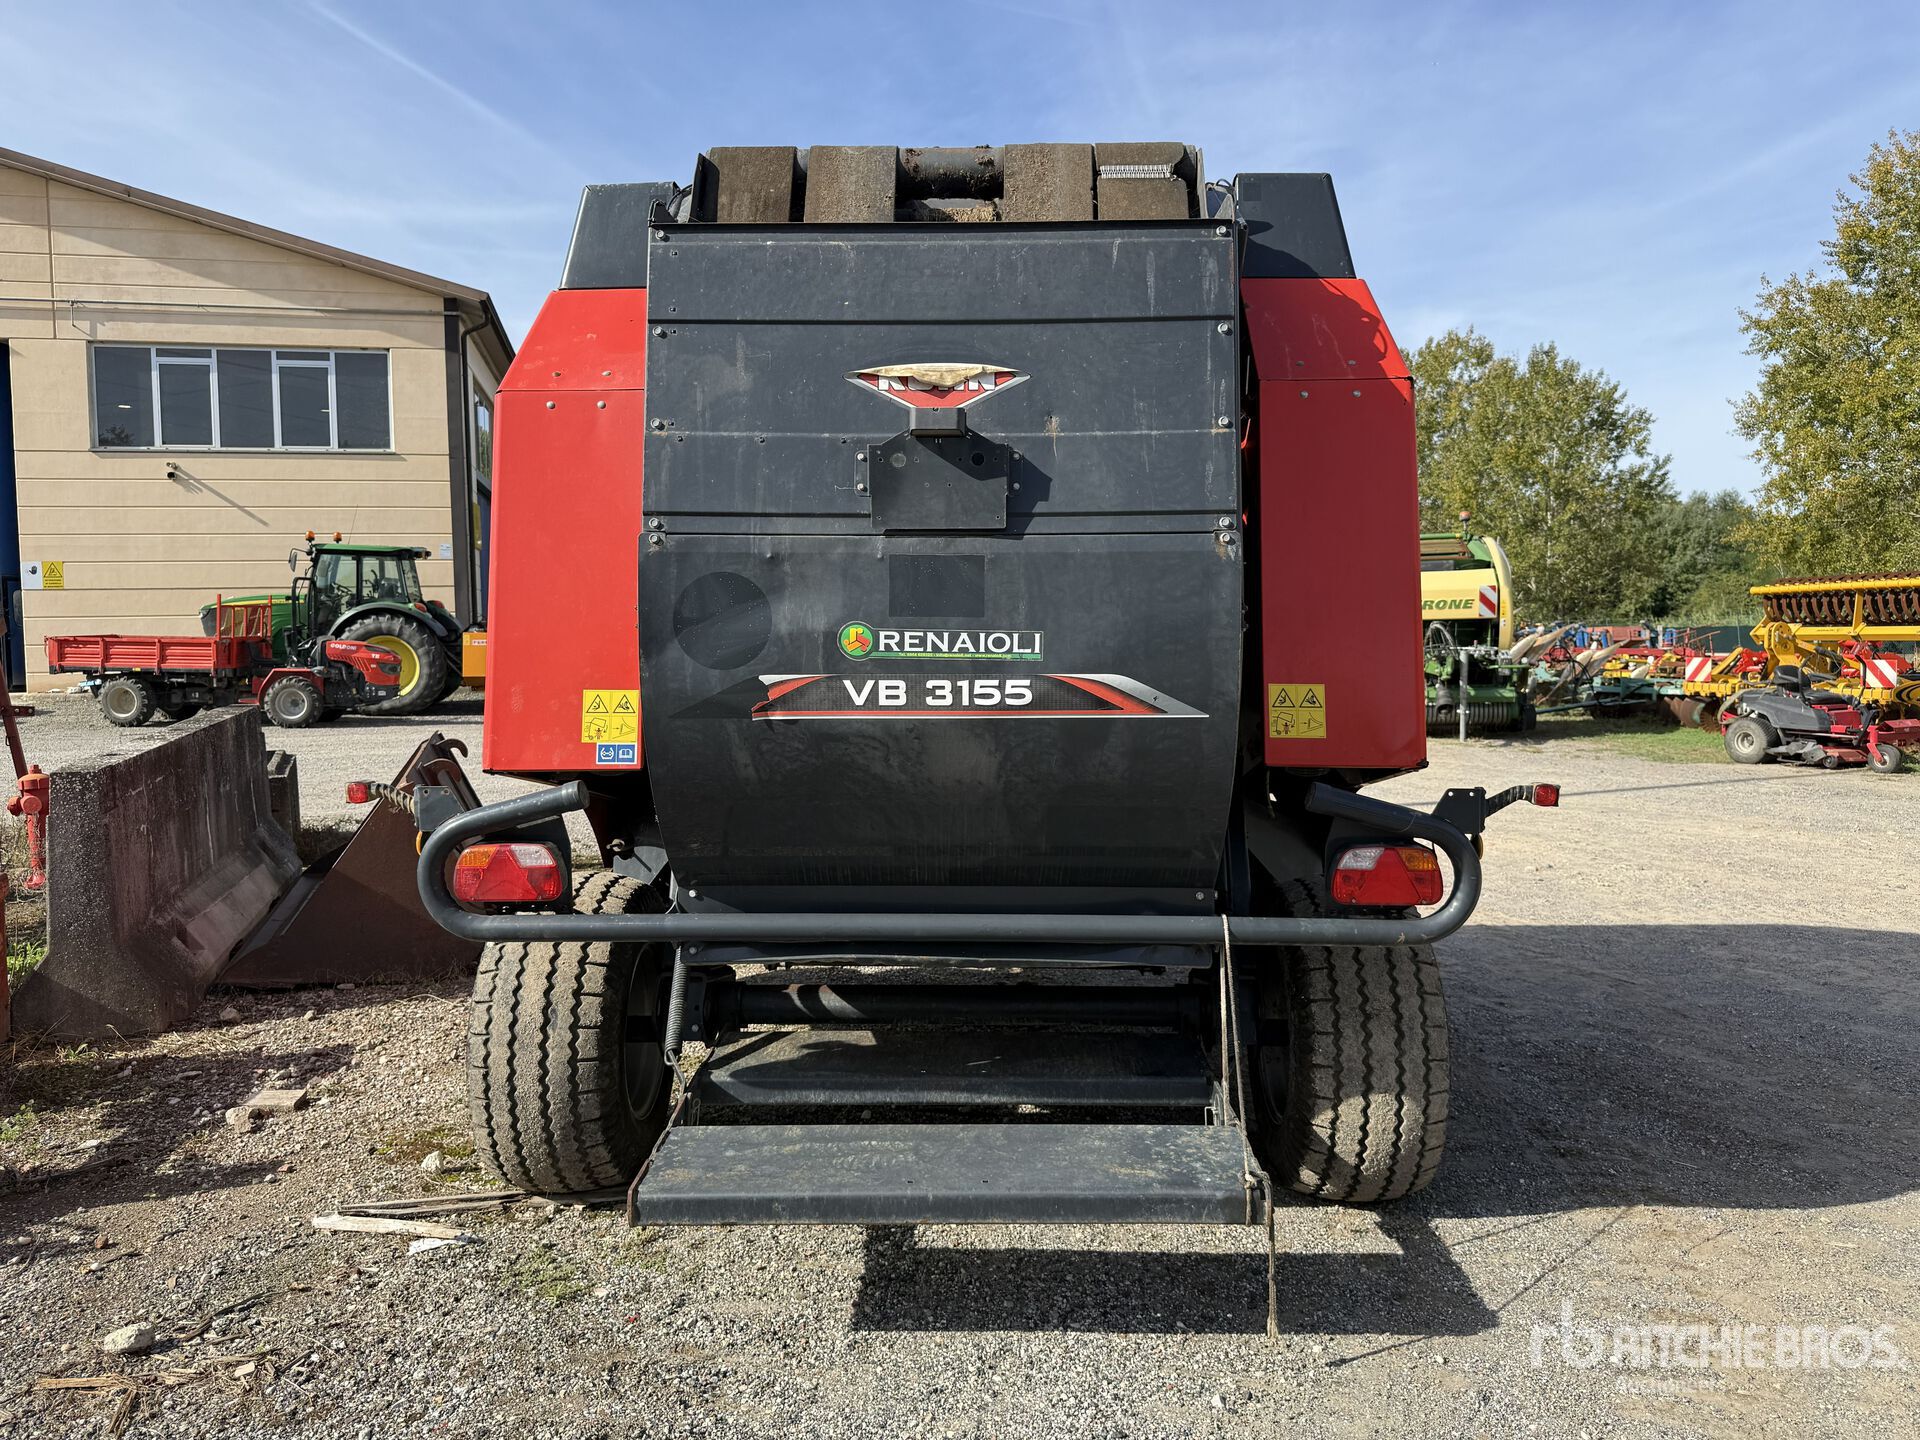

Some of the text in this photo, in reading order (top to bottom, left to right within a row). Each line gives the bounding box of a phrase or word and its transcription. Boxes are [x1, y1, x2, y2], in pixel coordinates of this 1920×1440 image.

[1421, 599, 1475, 610] RONE
[878, 630, 1041, 653] RENAIOLI
[843, 679, 1033, 706] VB 3155
